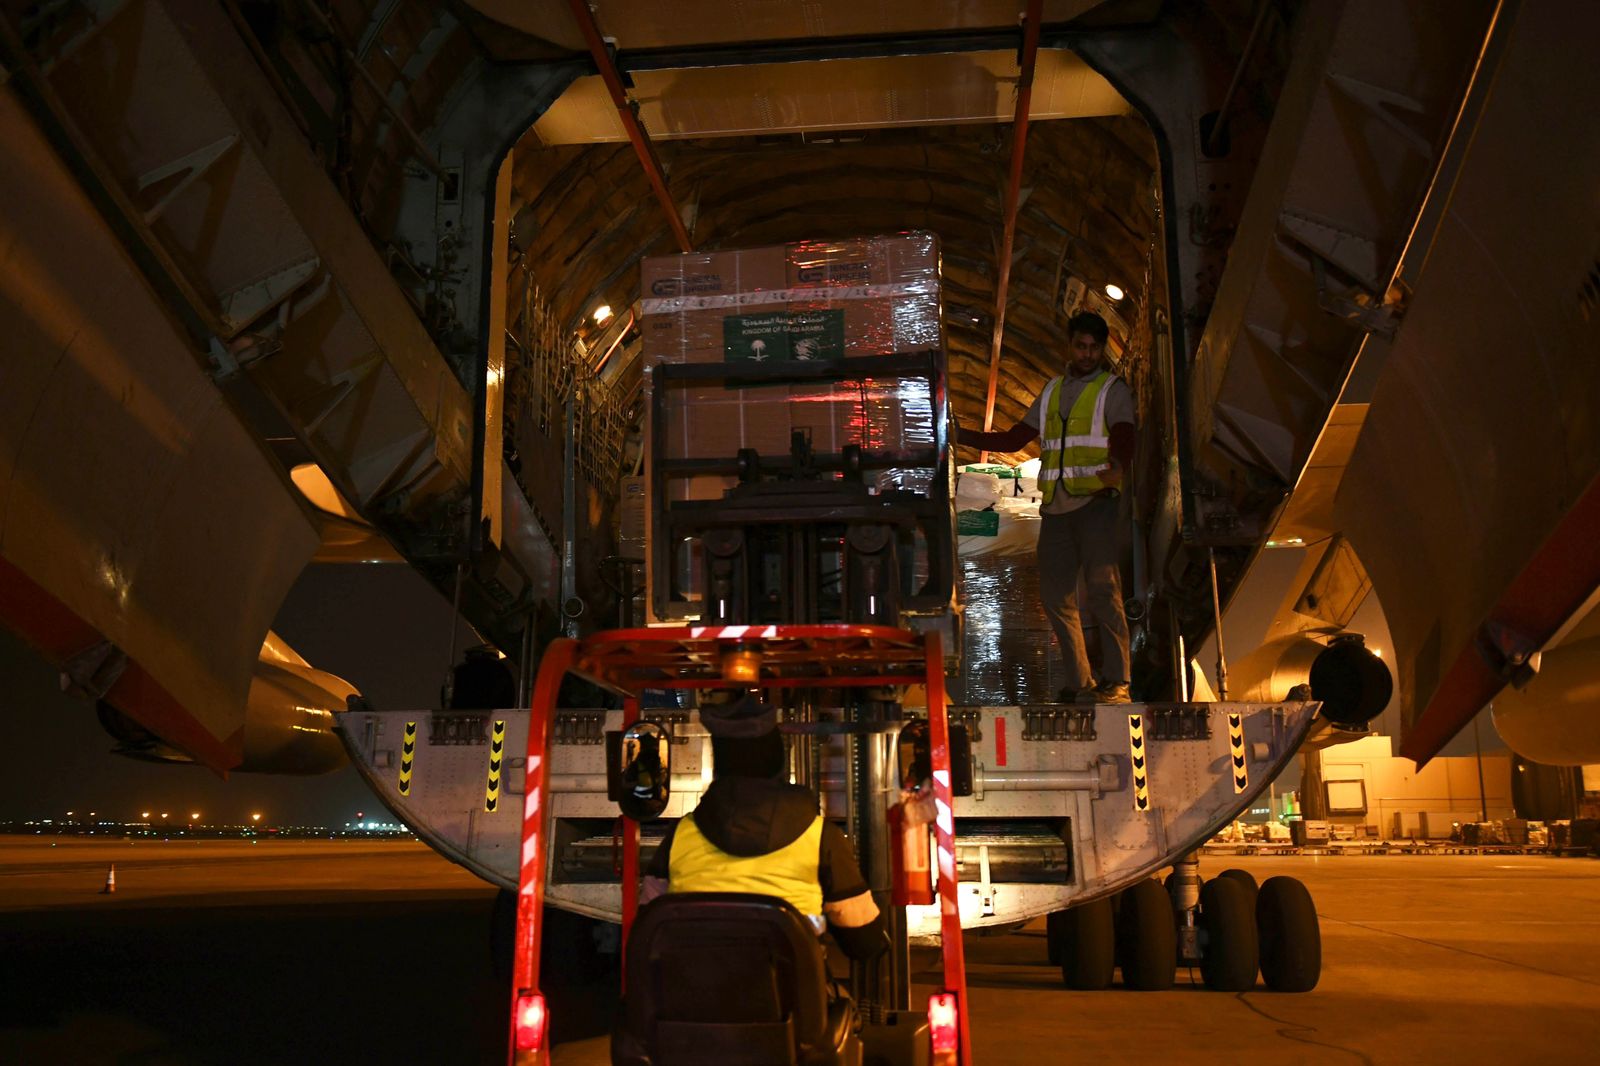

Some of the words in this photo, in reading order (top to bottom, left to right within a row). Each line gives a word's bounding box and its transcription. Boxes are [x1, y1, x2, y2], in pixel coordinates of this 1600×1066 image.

[742, 317, 774, 327] السعودية
[742, 327, 771, 335] KINGDOM
[772, 325, 781, 333] OF
[782, 325, 800, 333] SAUDI
[801, 324, 825, 332] ARABIA
